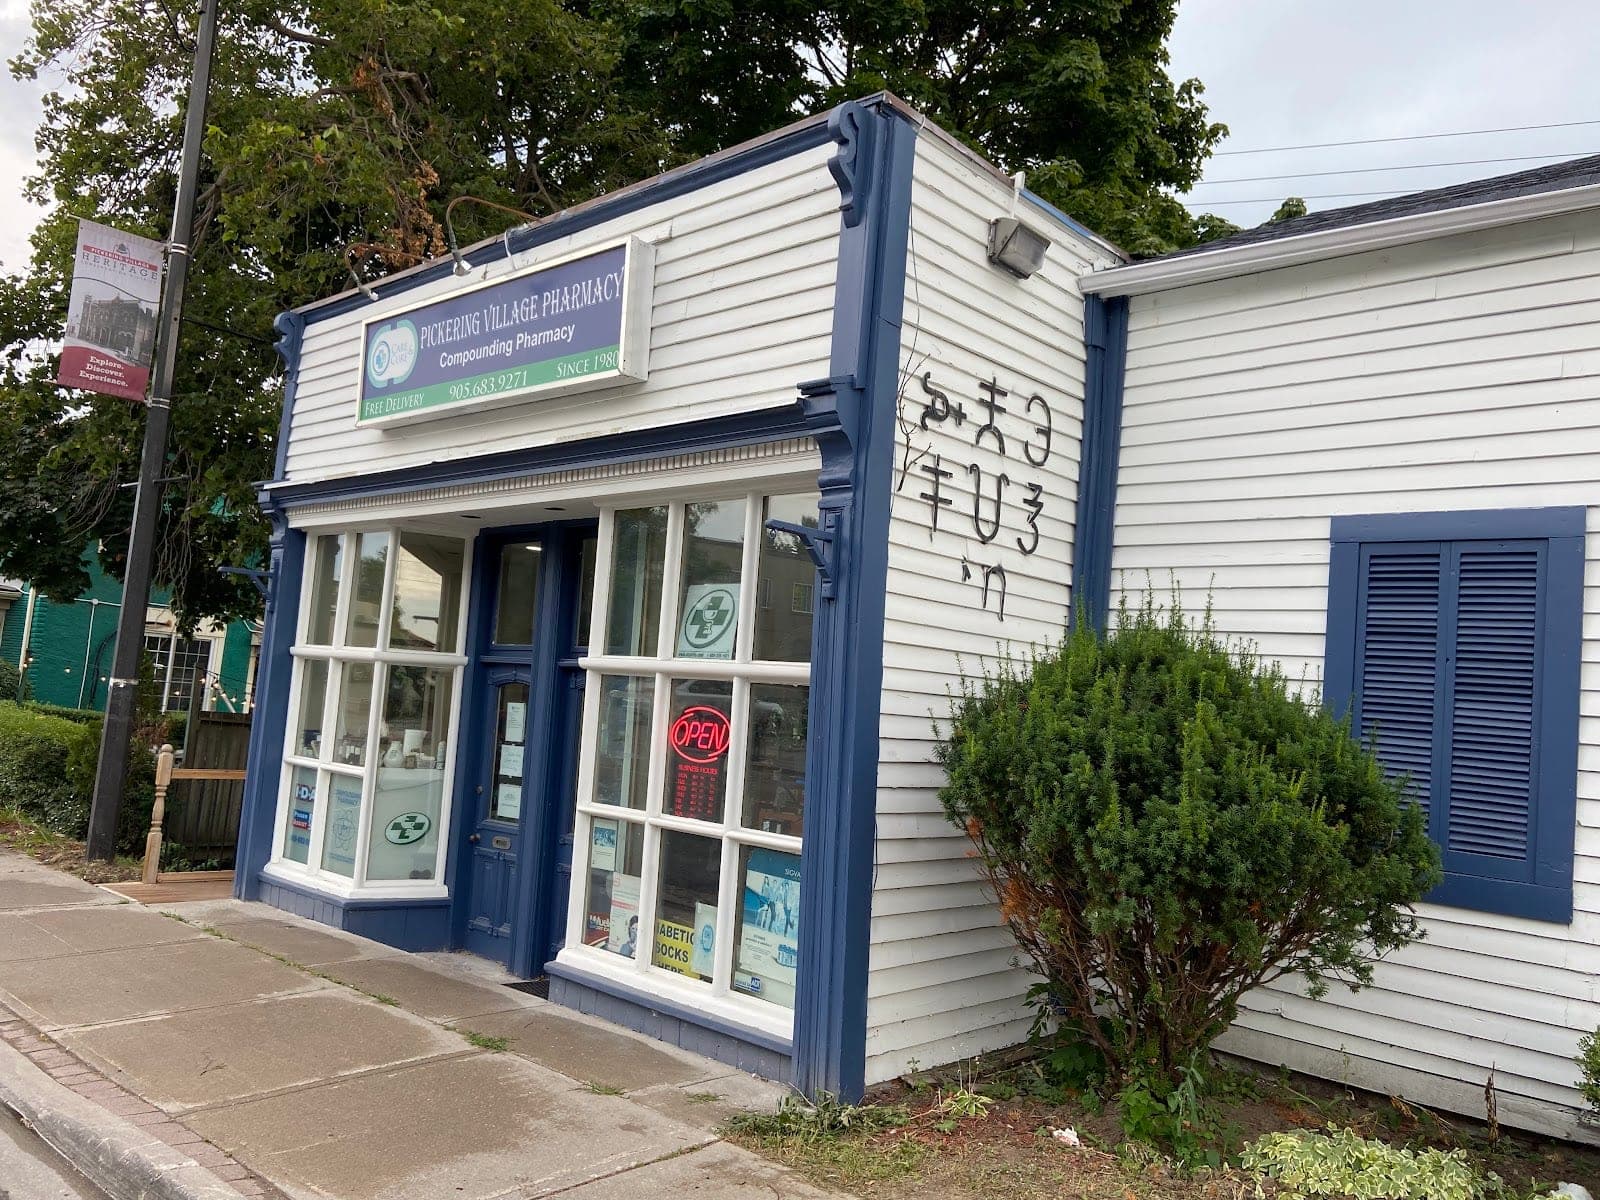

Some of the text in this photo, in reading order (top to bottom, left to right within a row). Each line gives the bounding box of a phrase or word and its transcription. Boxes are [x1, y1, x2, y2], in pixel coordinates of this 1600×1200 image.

[82, 251, 159, 280] HERITAGE
[420, 266, 625, 350] PICKERING VILLAGE PHARMACY
[439, 338, 513, 369] Compounding
[516, 323, 576, 352] Pharmacy
[86, 363, 125, 378] Discover.
[90, 356, 124, 370] Explore.
[556, 350, 620, 378] SINCE 1980
[79, 370, 129, 387] Experience.
[449, 370, 528, 400] 905.683.9271
[365, 392, 424, 417] FREE DELIVERY
[673, 719, 727, 750] OPEN
[656, 941, 689, 963] SOCKS
